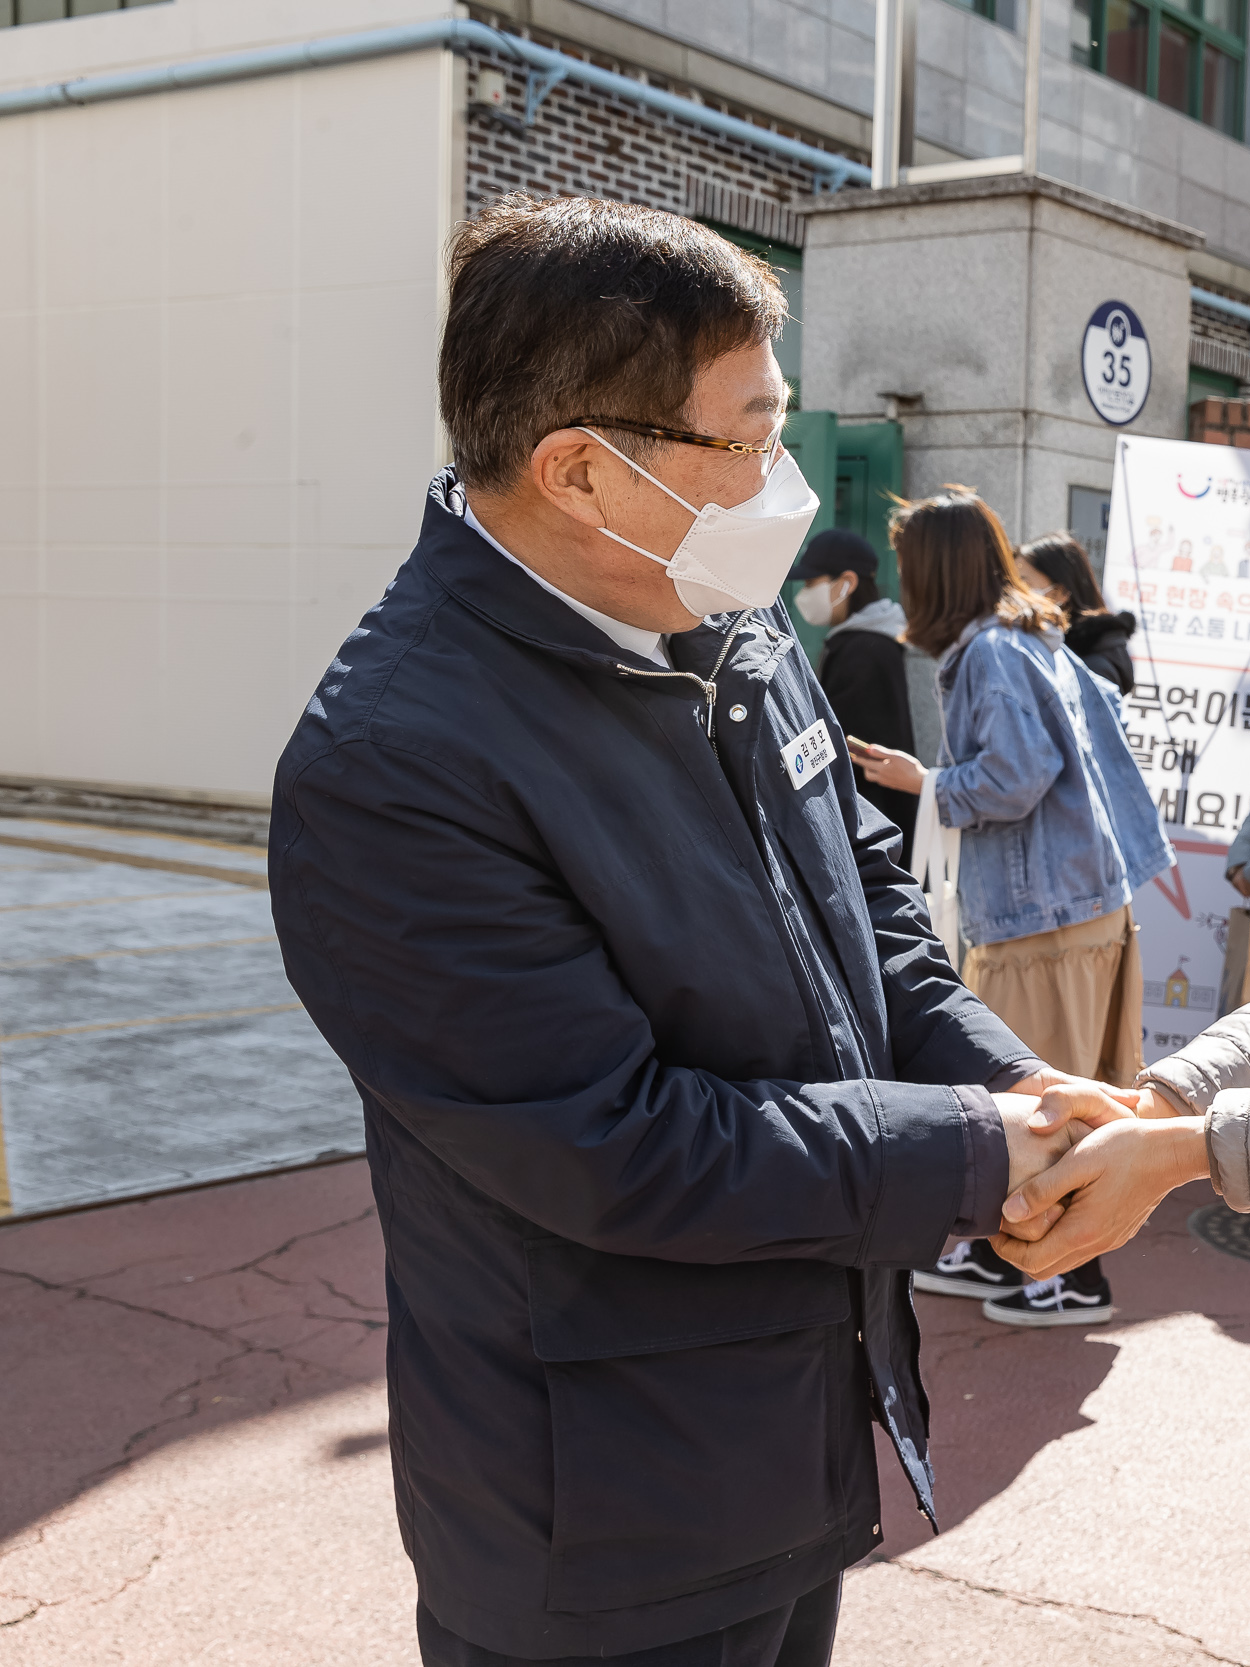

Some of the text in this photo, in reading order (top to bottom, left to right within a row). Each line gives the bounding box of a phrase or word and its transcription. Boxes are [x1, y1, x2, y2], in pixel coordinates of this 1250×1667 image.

[1102, 350, 1131, 388] 35
[1118, 580, 1157, 605] 학교
[1167, 585, 1209, 610] 현장
[1138, 610, 1178, 634] 교앞
[1186, 616, 1225, 640] 소통
[1126, 733, 1197, 774] 말해
